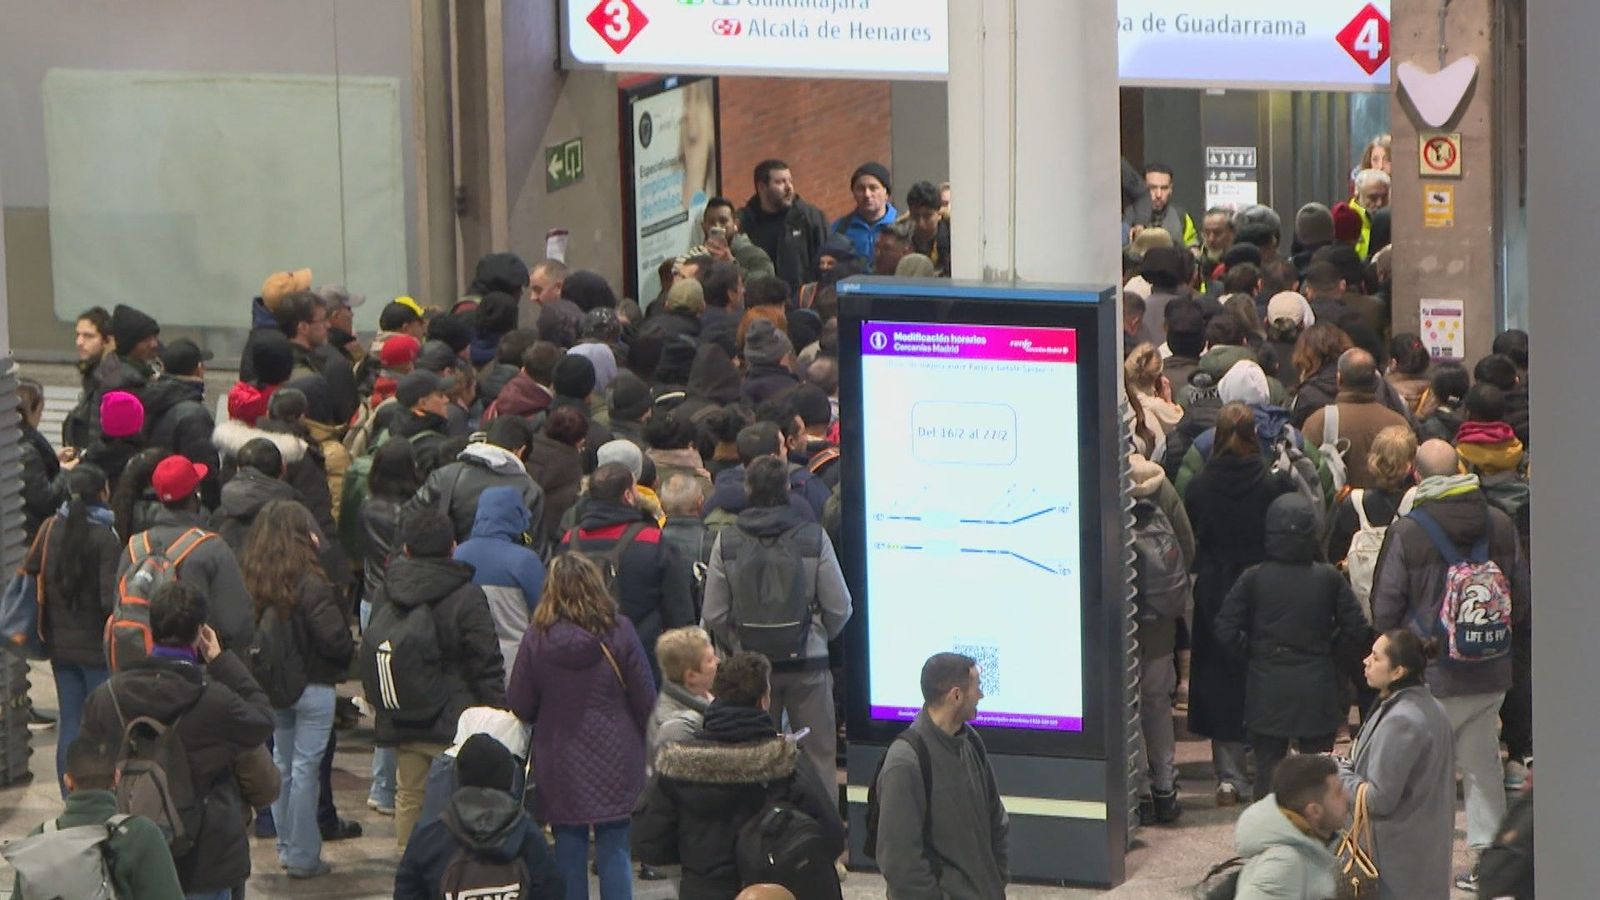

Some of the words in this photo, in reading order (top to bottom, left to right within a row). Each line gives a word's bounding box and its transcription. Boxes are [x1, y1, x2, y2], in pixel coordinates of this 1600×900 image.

[602, 2, 631, 41] 3
[748, 17, 809, 38] Alcalá
[817, 19, 841, 39] de
[849, 21, 931, 41] Henares
[1142, 12, 1167, 33] de
[1175, 13, 1306, 36] Guadarrama
[1354, 18, 1383, 60] 4
[950, 334, 987, 345] horarios
[932, 344, 959, 354] Madrid
[918, 426, 936, 437] Del
[969, 428, 979, 439] al
[1465, 630, 1483, 643] LIFE
[1485, 630, 1495, 643] IS
